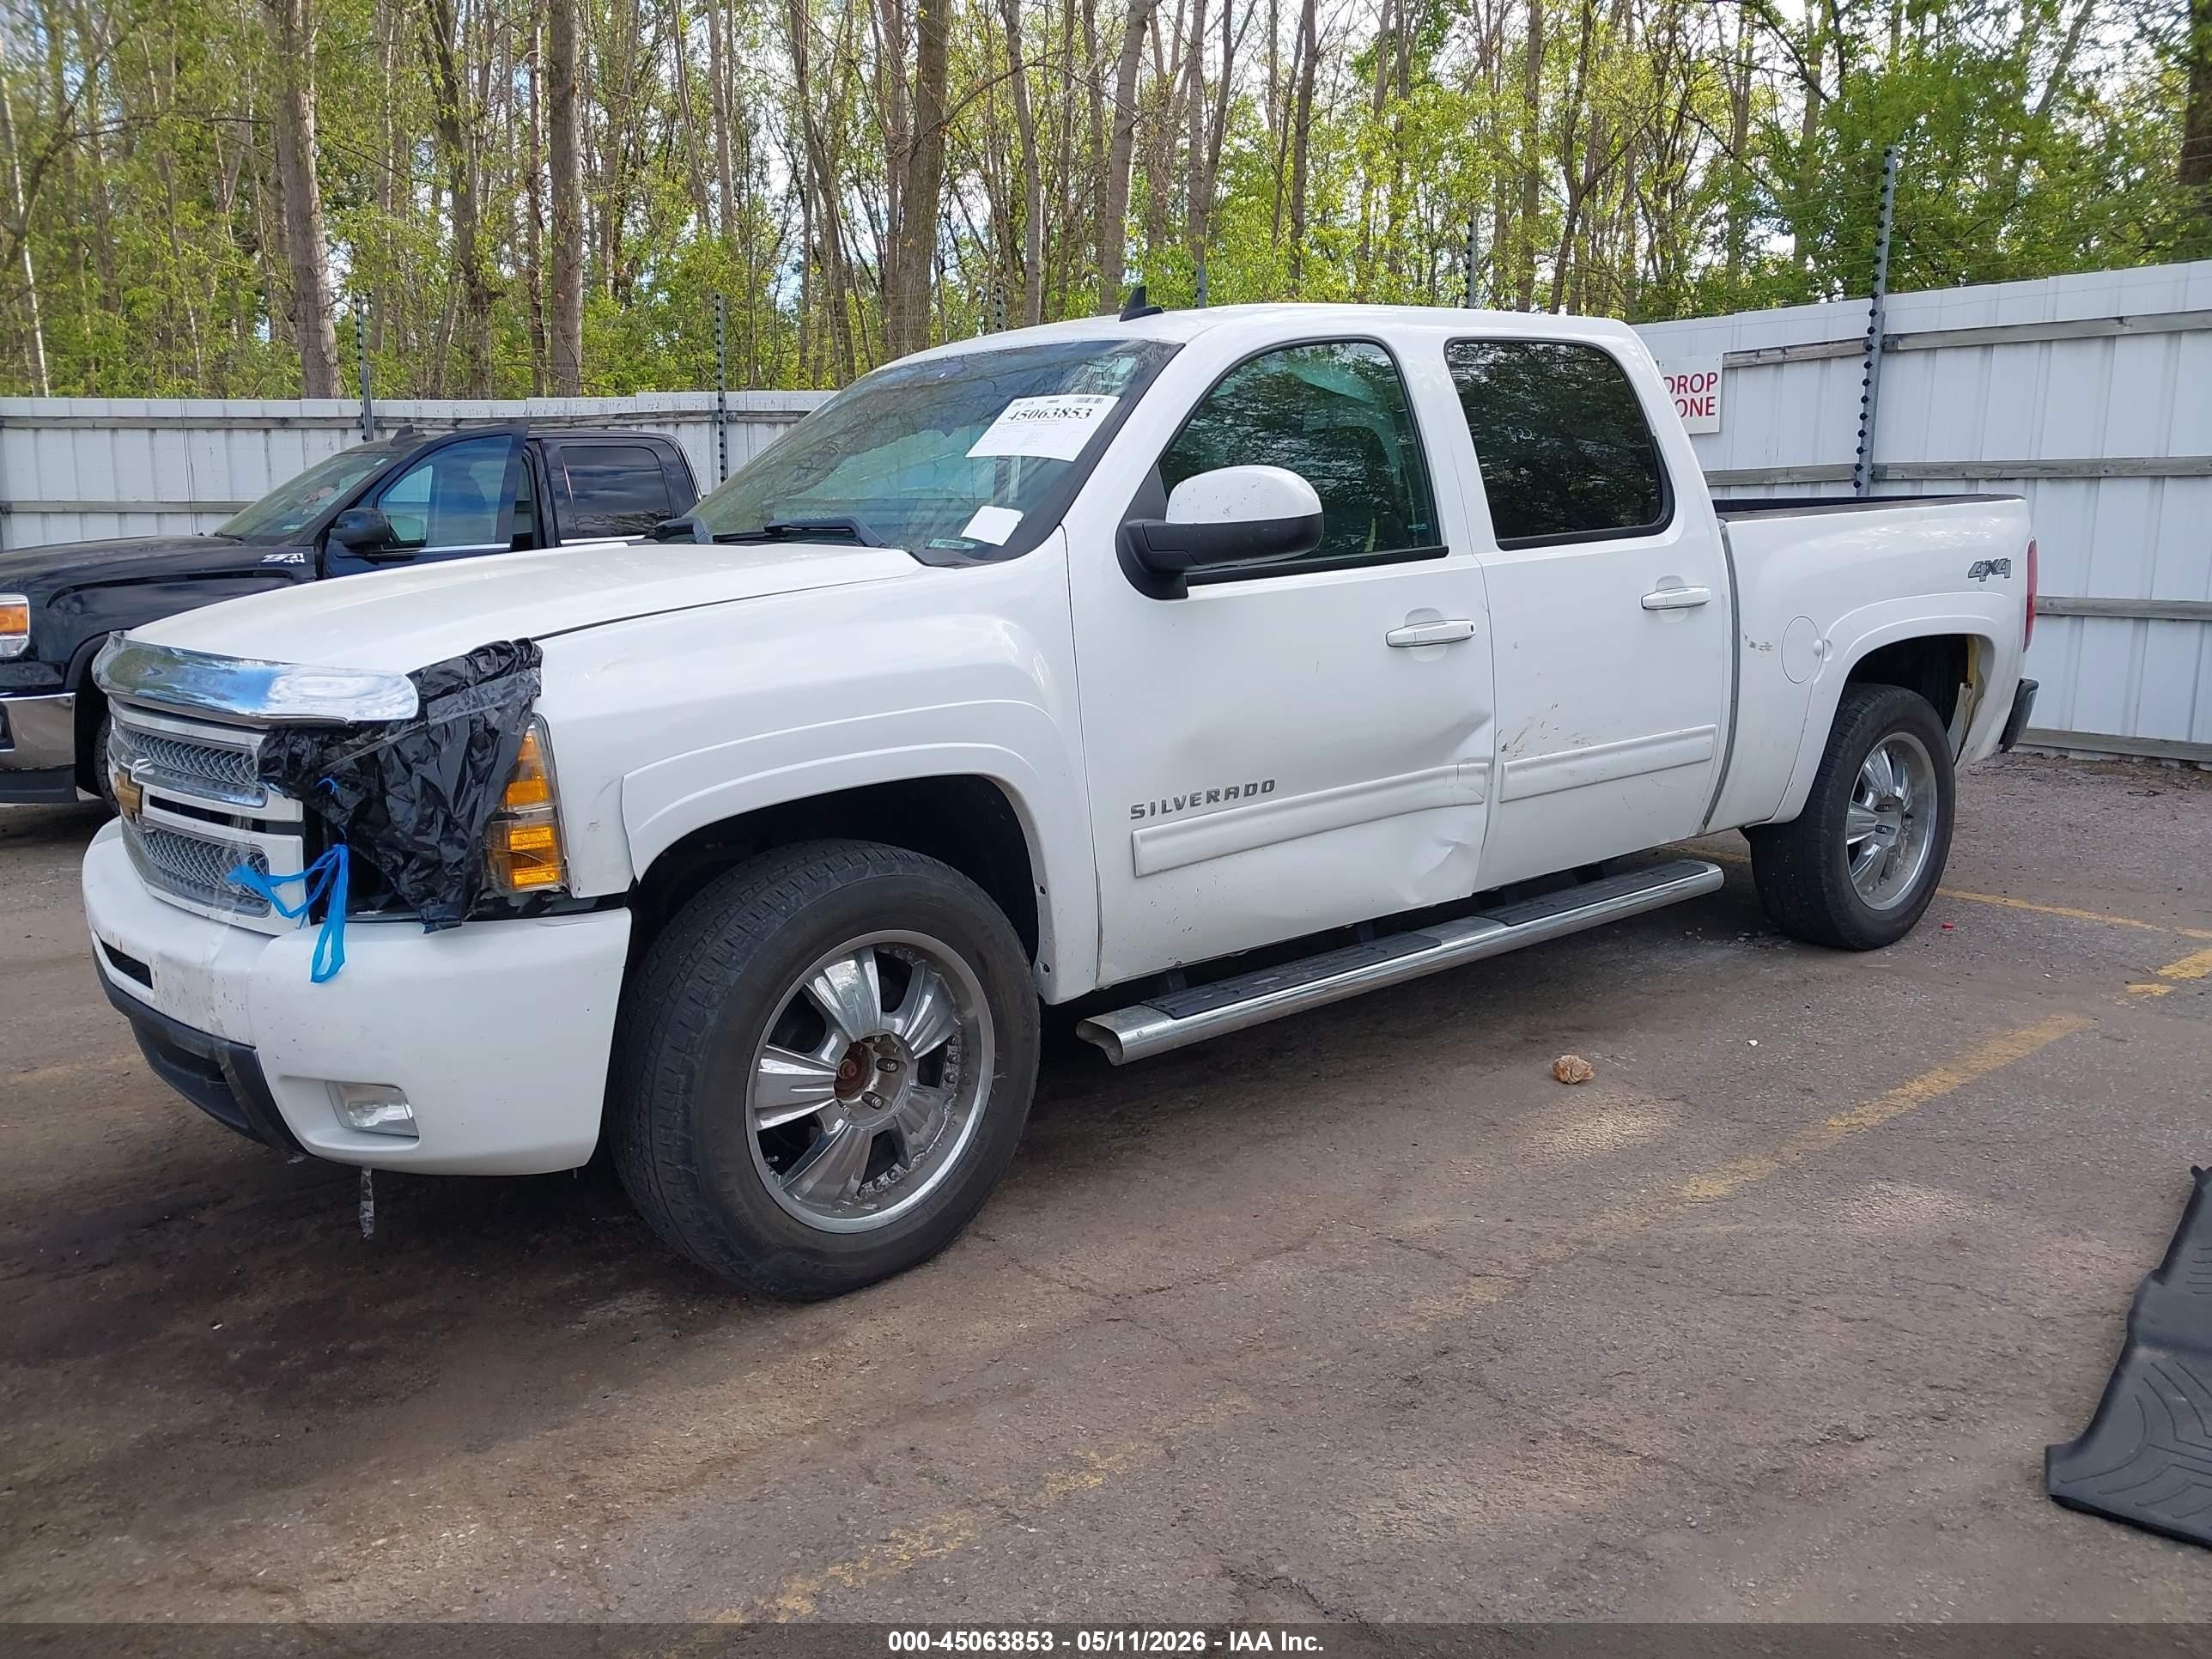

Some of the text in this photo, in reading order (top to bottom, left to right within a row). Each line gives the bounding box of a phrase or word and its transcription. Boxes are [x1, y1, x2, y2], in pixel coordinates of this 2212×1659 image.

[1663, 372, 1718, 395] DROP
[1007, 406, 1093, 421] 45063853
[1674, 396, 1716, 418] ONE
[1130, 779, 1276, 820] SILVERADO
